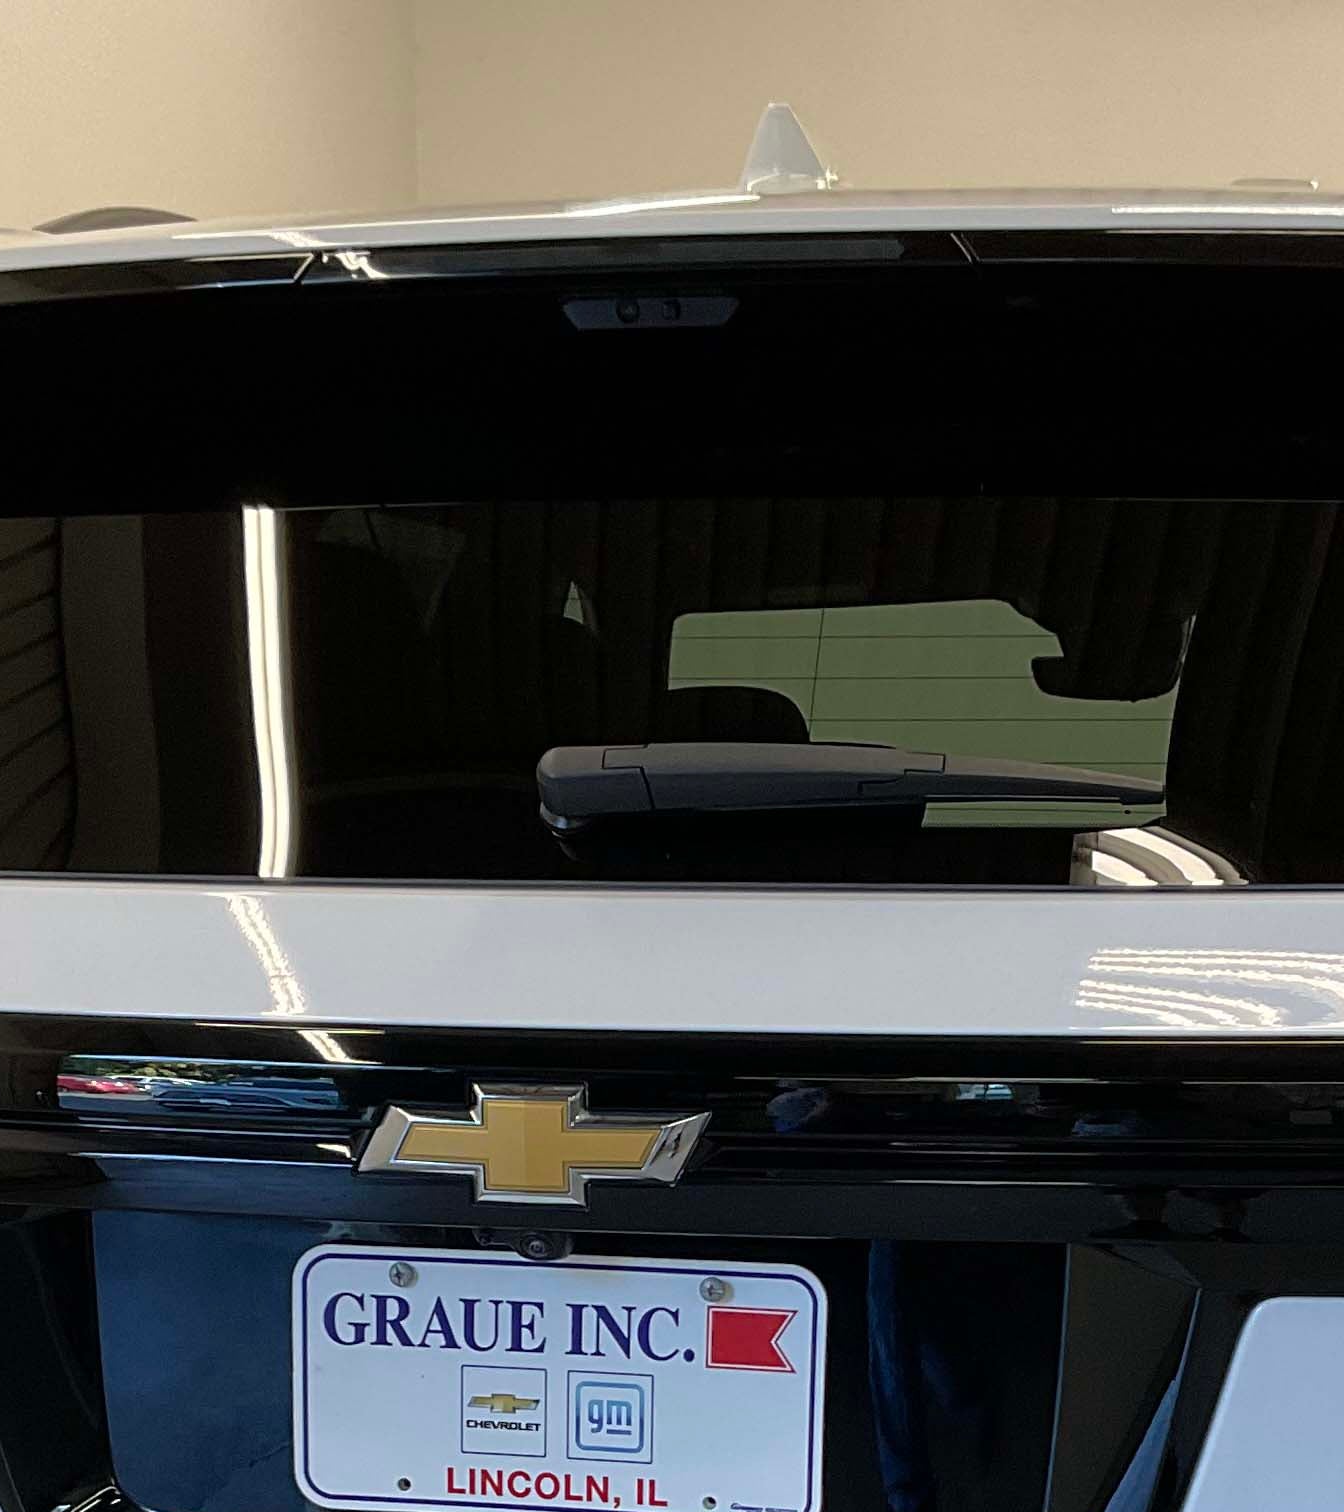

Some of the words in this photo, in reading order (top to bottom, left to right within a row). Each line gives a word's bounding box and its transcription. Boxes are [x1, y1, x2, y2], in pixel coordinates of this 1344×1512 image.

[323, 1292, 546, 1354] GRAUE
[565, 1303, 695, 1362] INC.
[465, 1419, 541, 1433] CHEVROLET
[587, 1399, 632, 1435] gm
[447, 1467, 622, 1506] LINCOLN,
[636, 1479, 668, 1507] IL
